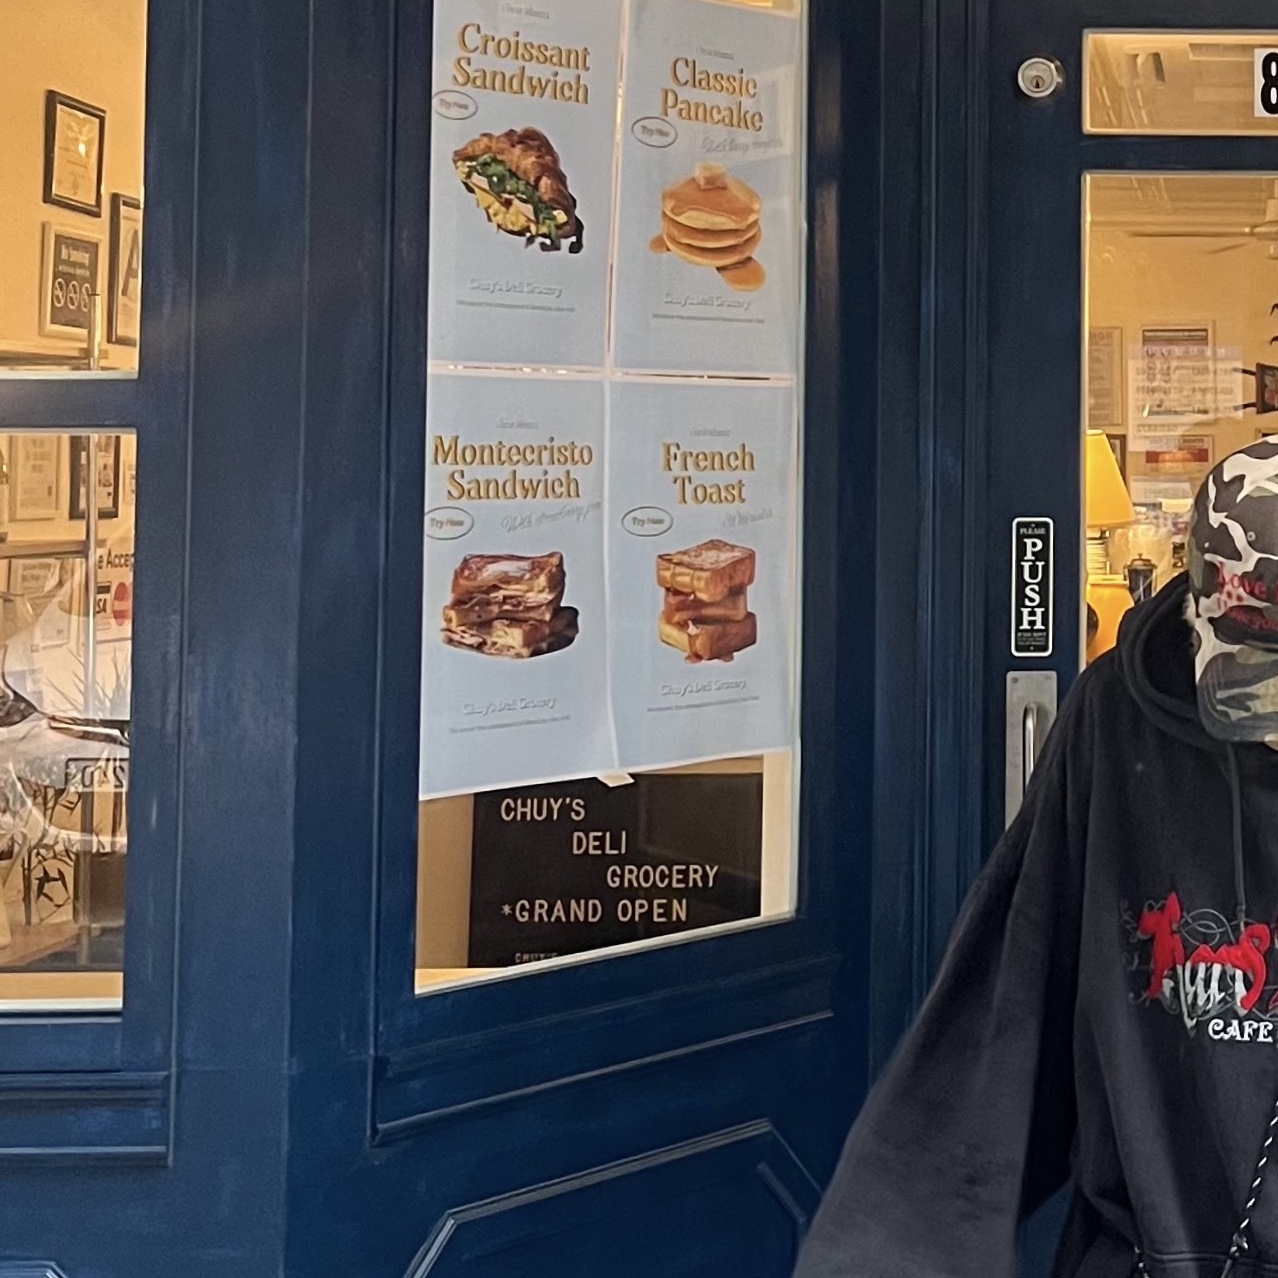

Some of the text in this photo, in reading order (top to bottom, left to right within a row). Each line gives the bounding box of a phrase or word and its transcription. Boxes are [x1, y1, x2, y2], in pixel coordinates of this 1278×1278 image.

[458, 22, 590, 71] Croissant
[453, 56, 589, 105] Sandwich
[670, 56, 758, 99] Classic
[660, 88, 763, 132] Pancake
[432, 434, 593, 467] Montecristo
[661, 442, 755, 472] French
[447, 469, 581, 501] Sandwich
[673, 475, 746, 505] Toast
[1019, 537, 1046, 629] PUSH
[1216, 561, 1267, 597] Love
[501, 798, 586, 821] CHUY'S
[572, 830, 627, 855] DELI
[606, 864, 719, 888] GROCERY
[617, 898, 687, 922] OPEN
[1208, 1018, 1273, 1042] CAFE
